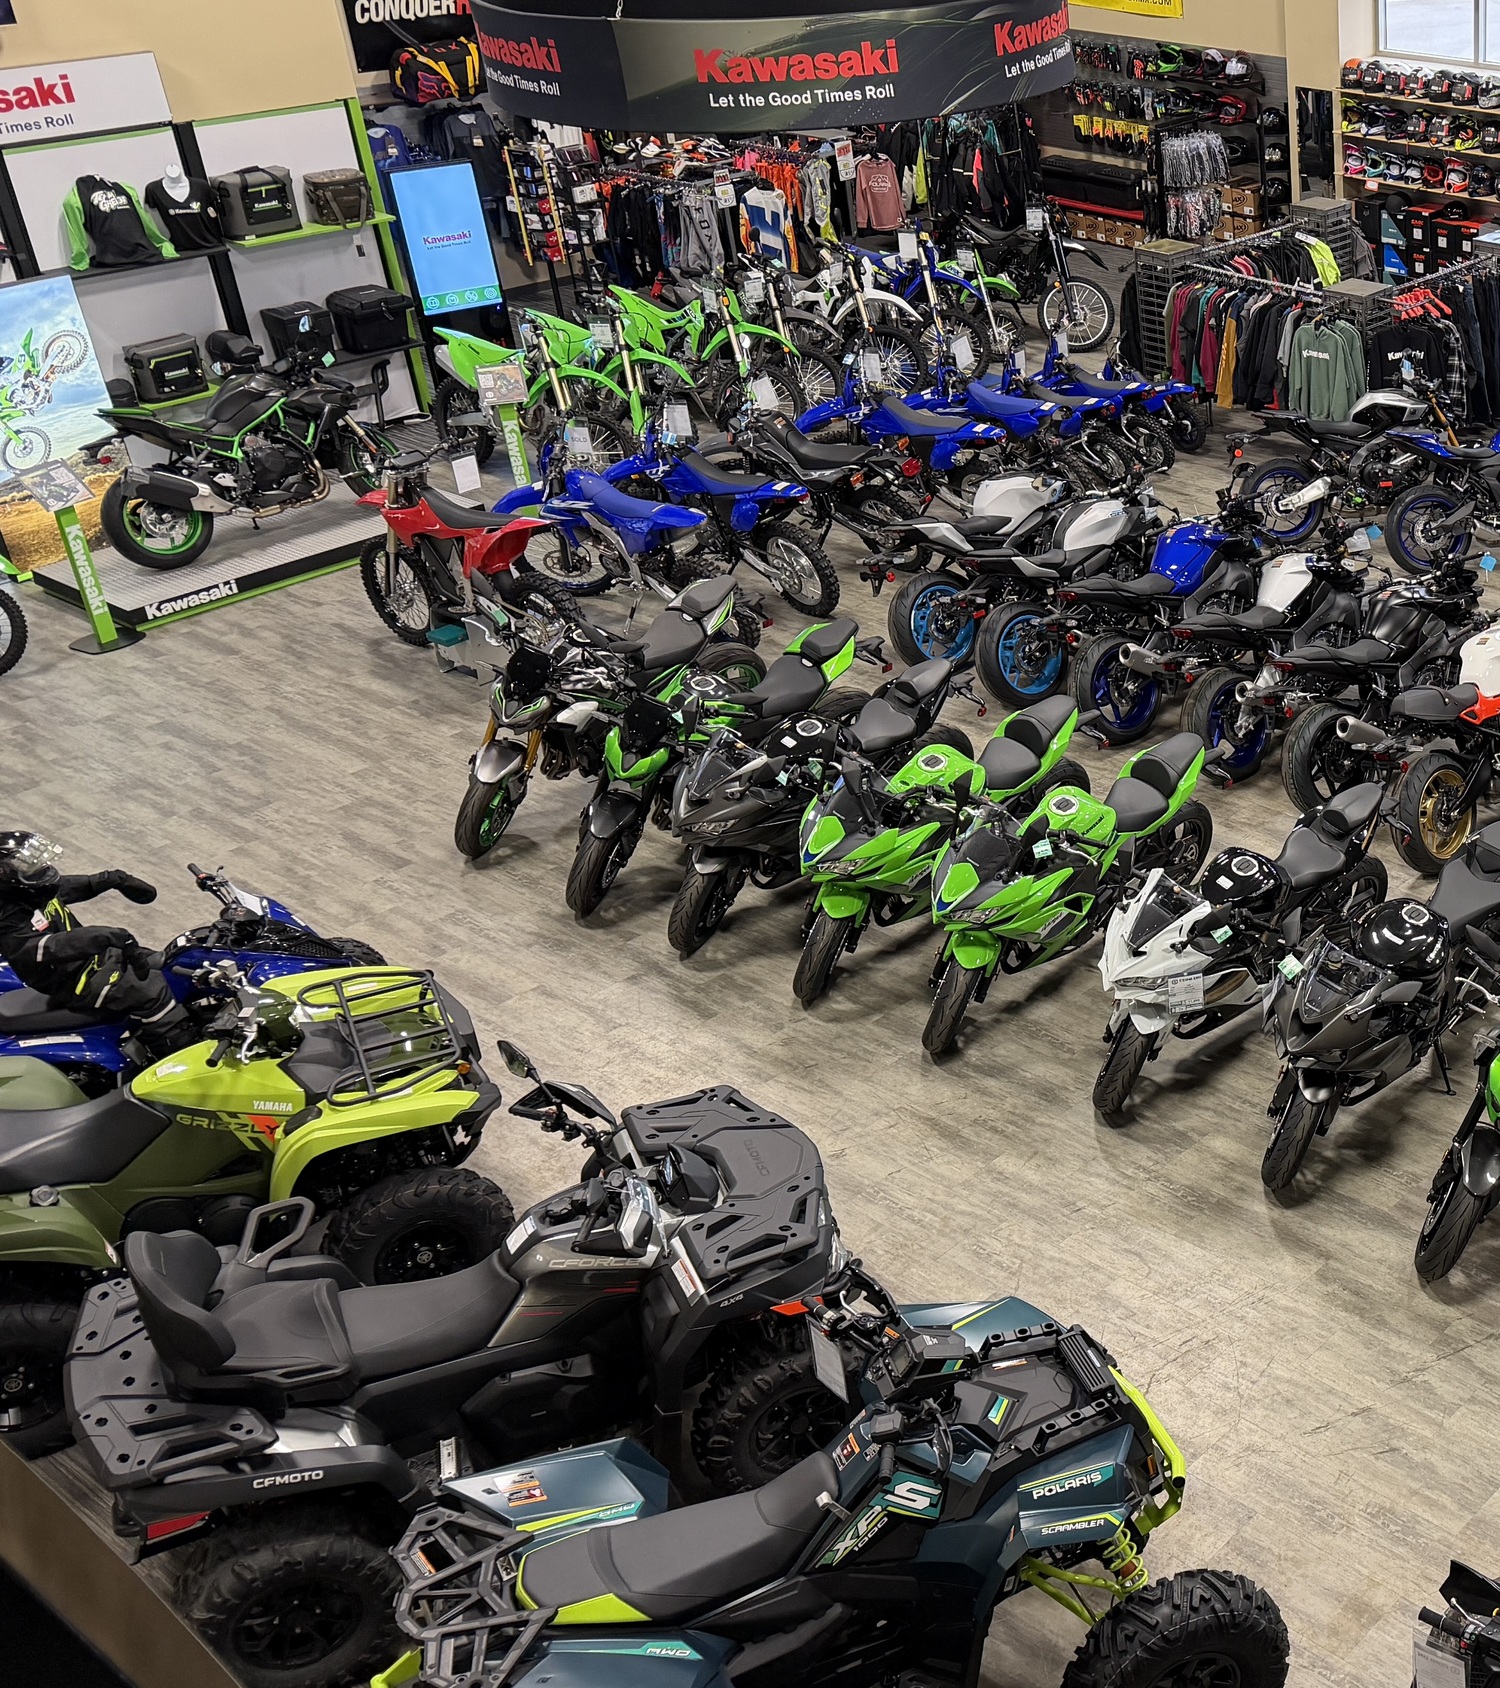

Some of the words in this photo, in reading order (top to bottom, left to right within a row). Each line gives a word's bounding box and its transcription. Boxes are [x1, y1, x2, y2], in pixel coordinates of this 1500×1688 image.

[693, 38, 899, 84] Kawasaki
[1005, 64, 1020, 78] Let
[1022, 59, 1035, 71] the
[1036, 52, 1053, 67] Good
[514, 76, 539, 93] Times
[540, 81, 561, 96] Roll
[709, 93, 735, 108] Let
[739, 93, 765, 107] the
[769, 90, 811, 106] Good
[814, 87, 862, 103] Times
[865, 84, 895, 99] Roll
[44, 113, 74, 128] Roll
[423, 230, 472, 245] Kawasaki
[571, 436, 588, 444] SOLD
[502, 420, 527, 488] Kawasa
[65, 524, 108, 615] Kawasaki
[145, 580, 238, 620] Kawasaki
[253, 1100, 293, 1111] YAMAHA
[176, 1113, 280, 1134] GRIZZLY
[548, 1257, 641, 1269] CFORCE
[253, 1470, 324, 1489] CFMOTO
[1032, 1471, 1102, 1500] POLARIS
[853, 1516, 889, 1552] 1000
[1041, 1519, 1105, 1536] SCRAMBLER
